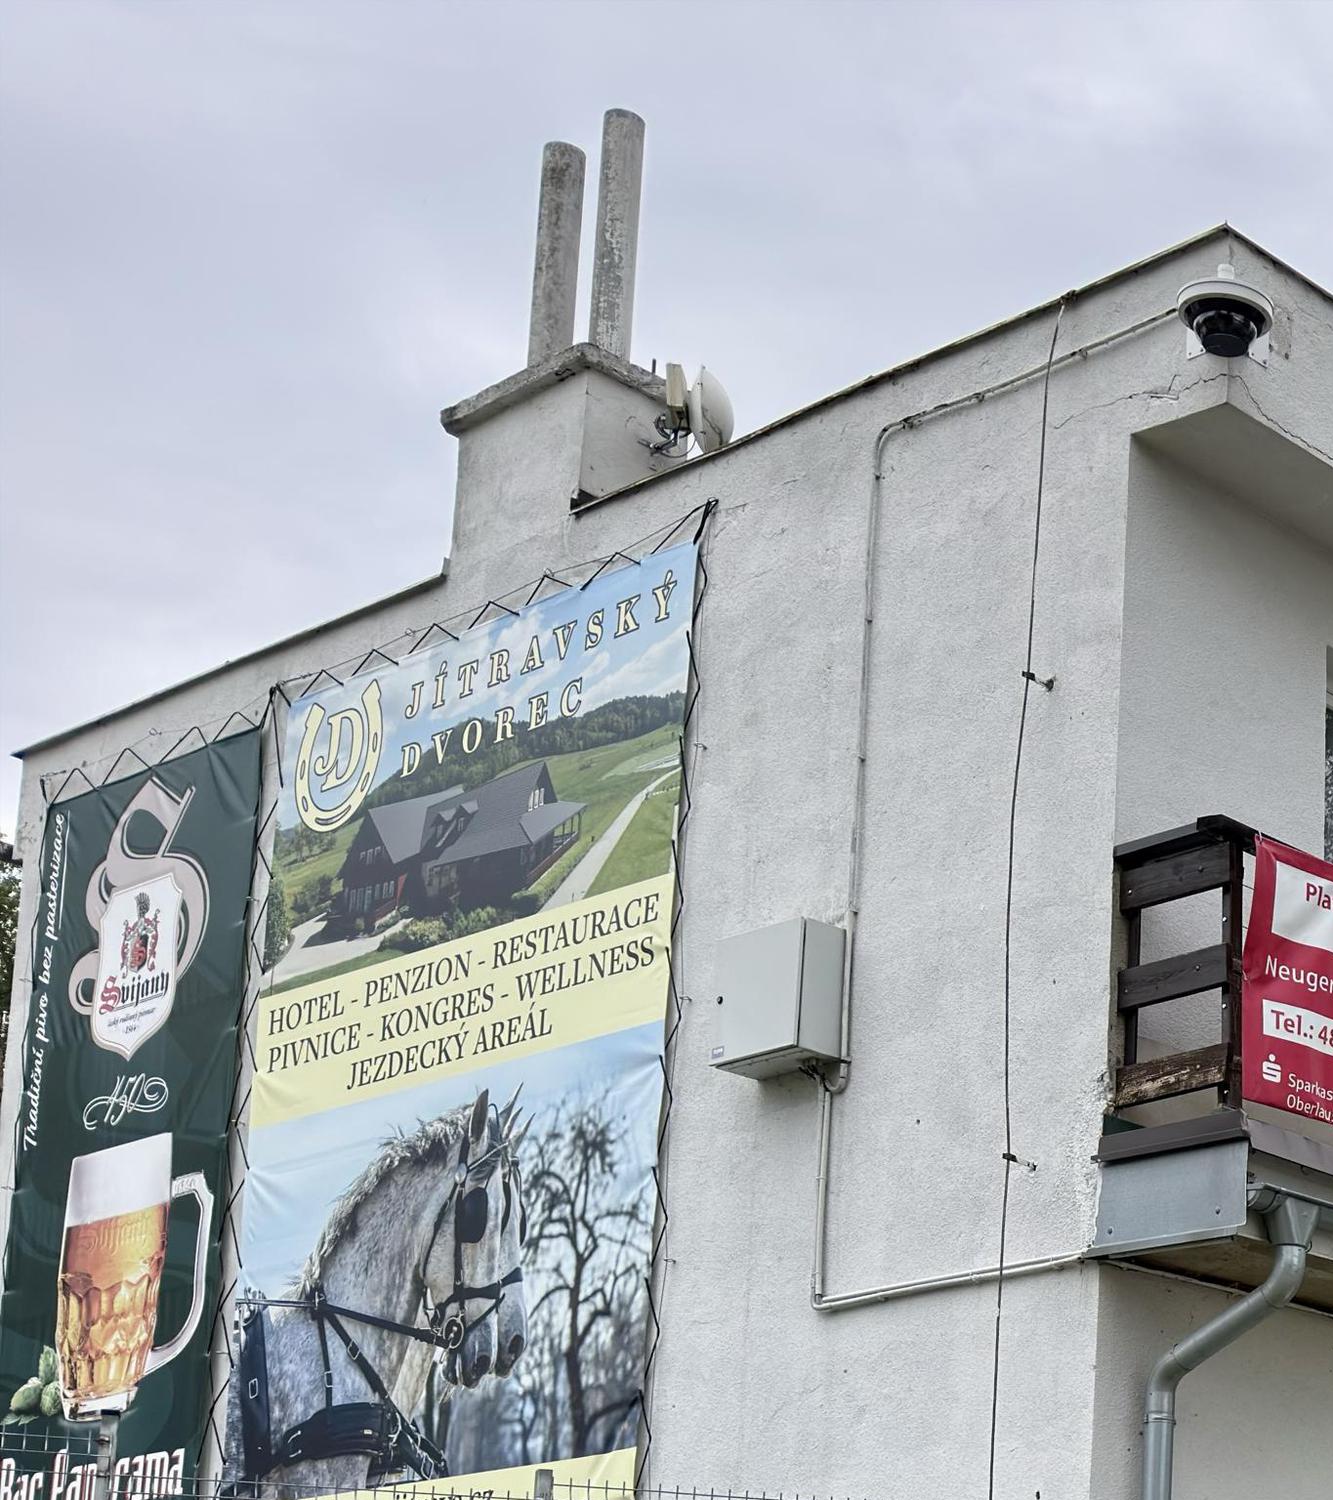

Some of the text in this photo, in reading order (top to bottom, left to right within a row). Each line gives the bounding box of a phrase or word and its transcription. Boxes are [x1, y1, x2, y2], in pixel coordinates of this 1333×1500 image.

[404, 569, 678, 719] JÍTRAVSKÝ
[400, 677, 583, 778] DVOREC
[23, 812, 66, 1152] Tradiční pivo bez pasterizace
[99, 970, 170, 1016] Svijany
[267, 998, 345, 1036] HOTEL
[363, 949, 473, 1009] PENZION
[491, 892, 660, 970] RESTAURACE
[267, 1022, 361, 1074] PIVNICE
[380, 983, 495, 1042] KONGRES
[516, 936, 656, 1001] WELLNESS
[346, 1001, 553, 1090] JEZDECKÝ AREÁL
[1270, 1008, 1314, 1041] Tel.:
